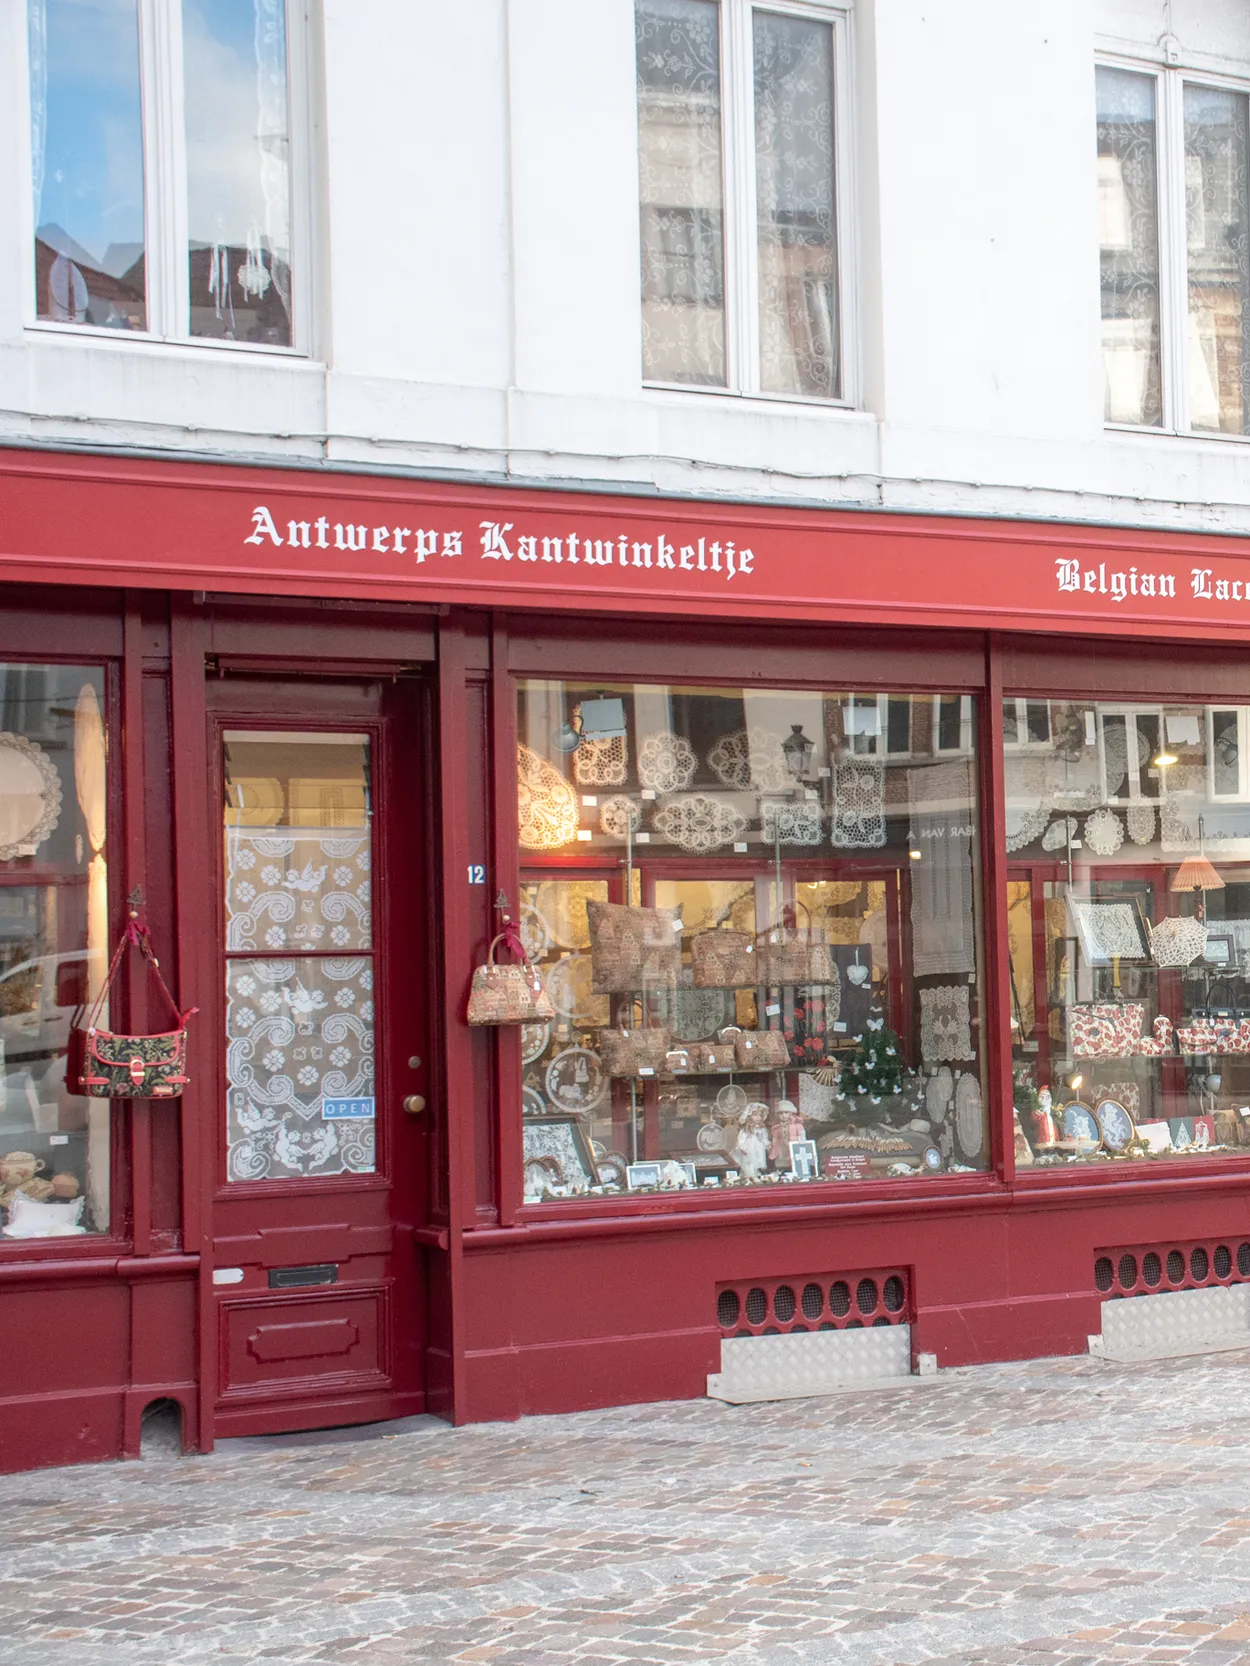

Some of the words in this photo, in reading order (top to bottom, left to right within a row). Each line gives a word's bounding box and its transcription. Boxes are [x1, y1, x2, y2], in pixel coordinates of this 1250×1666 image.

[243, 506, 463, 564] Antwerps
[479, 521, 755, 580] Kantwinkeltje
[1055, 558, 1176, 602] Belgian
[467, 865, 484, 884] 12
[325, 1103, 370, 1115] OPEN
